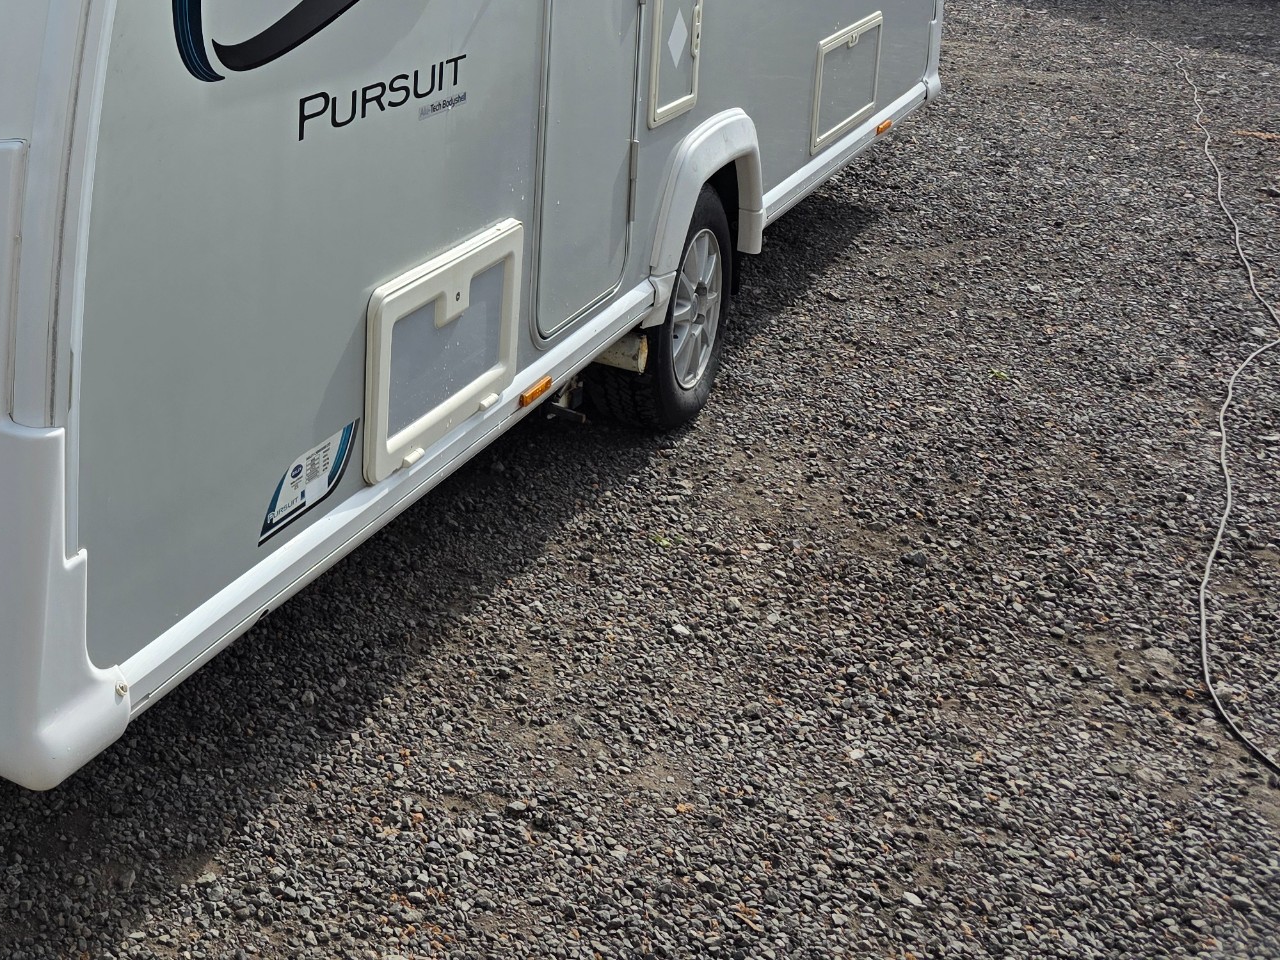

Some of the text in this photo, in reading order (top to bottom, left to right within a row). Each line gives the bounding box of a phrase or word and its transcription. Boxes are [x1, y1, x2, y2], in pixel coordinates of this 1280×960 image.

[298, 54, 467, 141] PURSUIT
[442, 91, 466, 108] Bodyshell
[267, 497, 298, 523] PURSUIT
